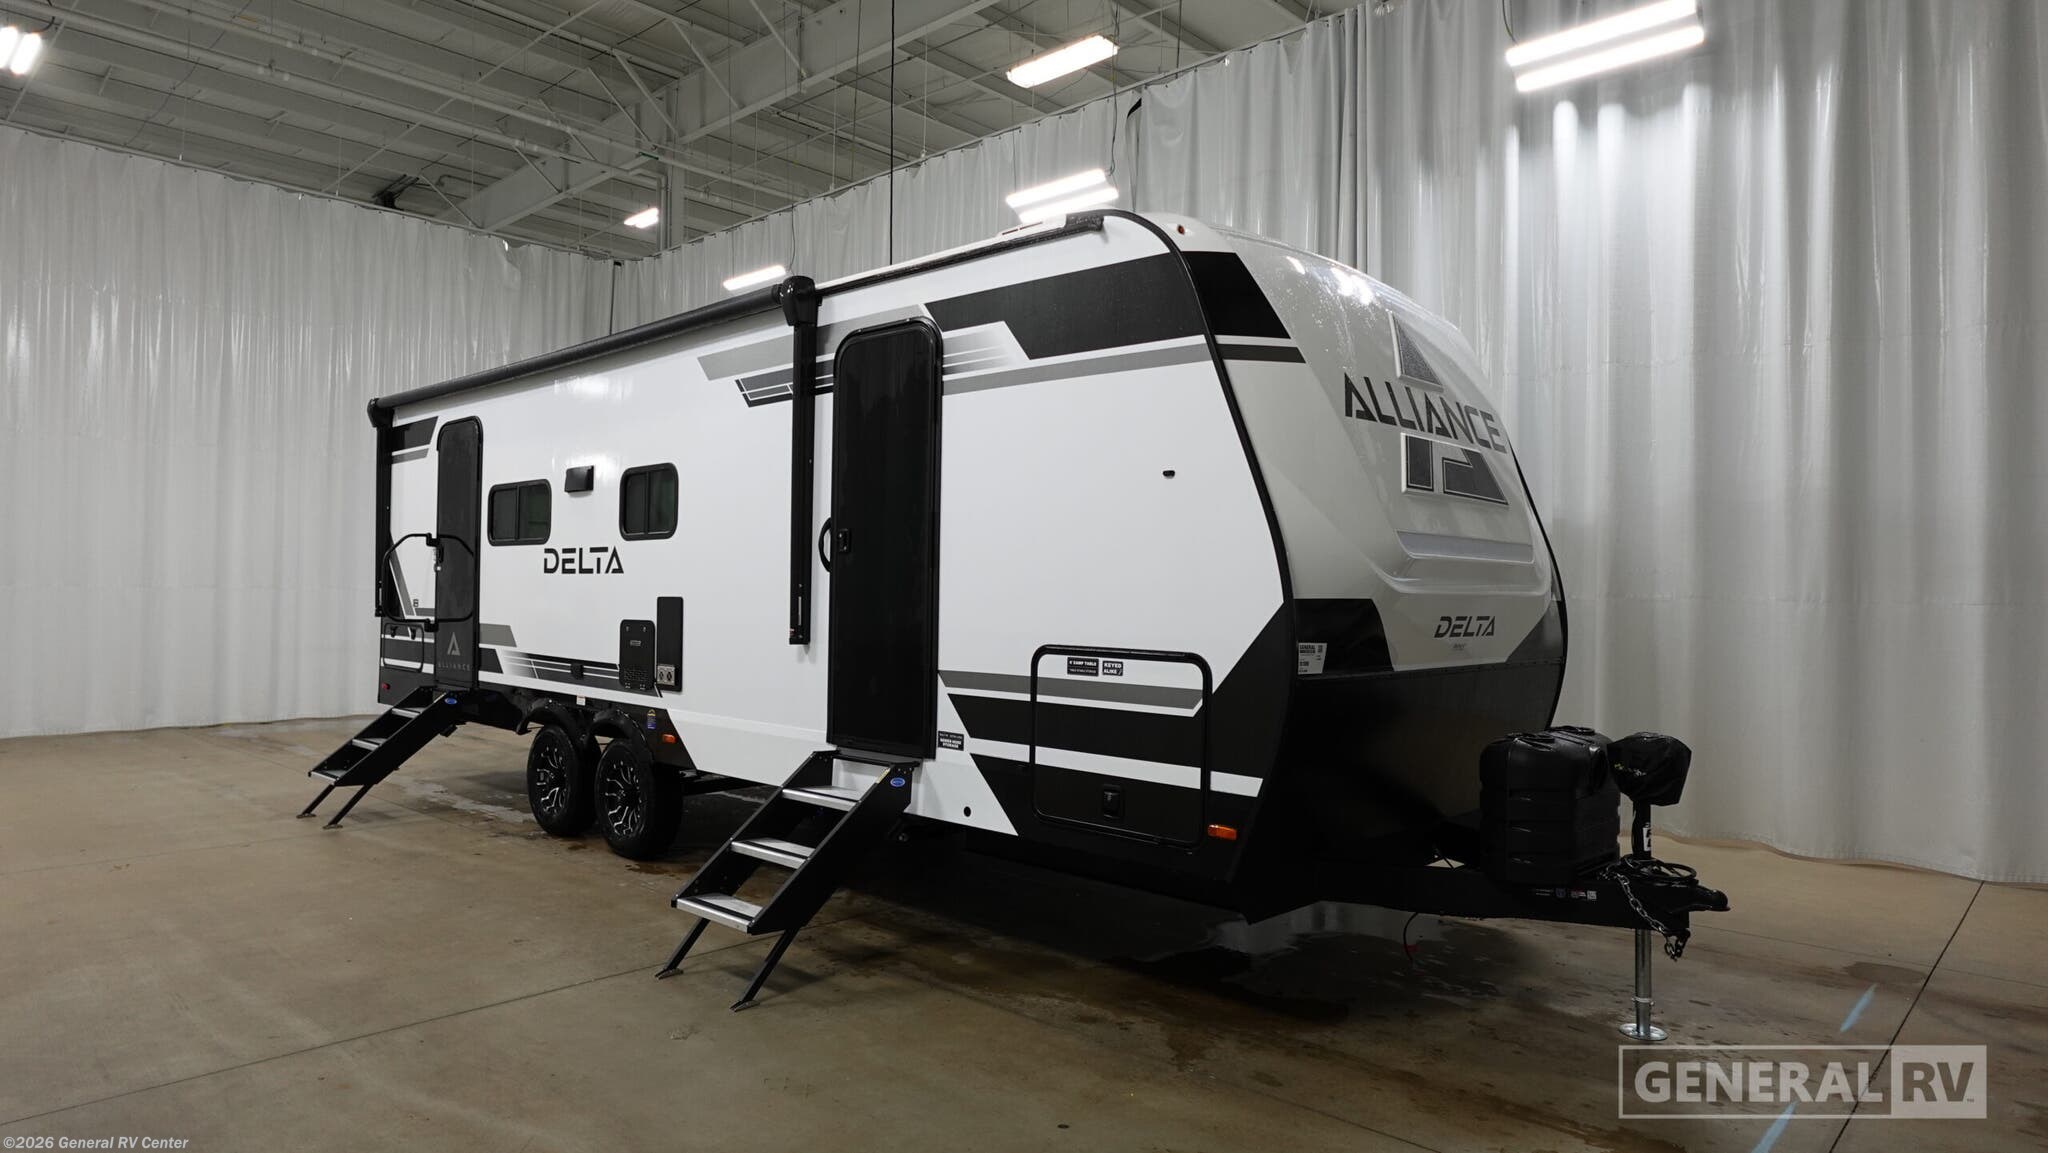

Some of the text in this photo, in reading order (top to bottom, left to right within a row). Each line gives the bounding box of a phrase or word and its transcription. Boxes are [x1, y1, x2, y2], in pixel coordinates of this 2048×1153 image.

[1344, 372, 1507, 454] ALLIANCE
[544, 546, 624, 574] DELTA
[1434, 616, 1495, 638] DELTA
